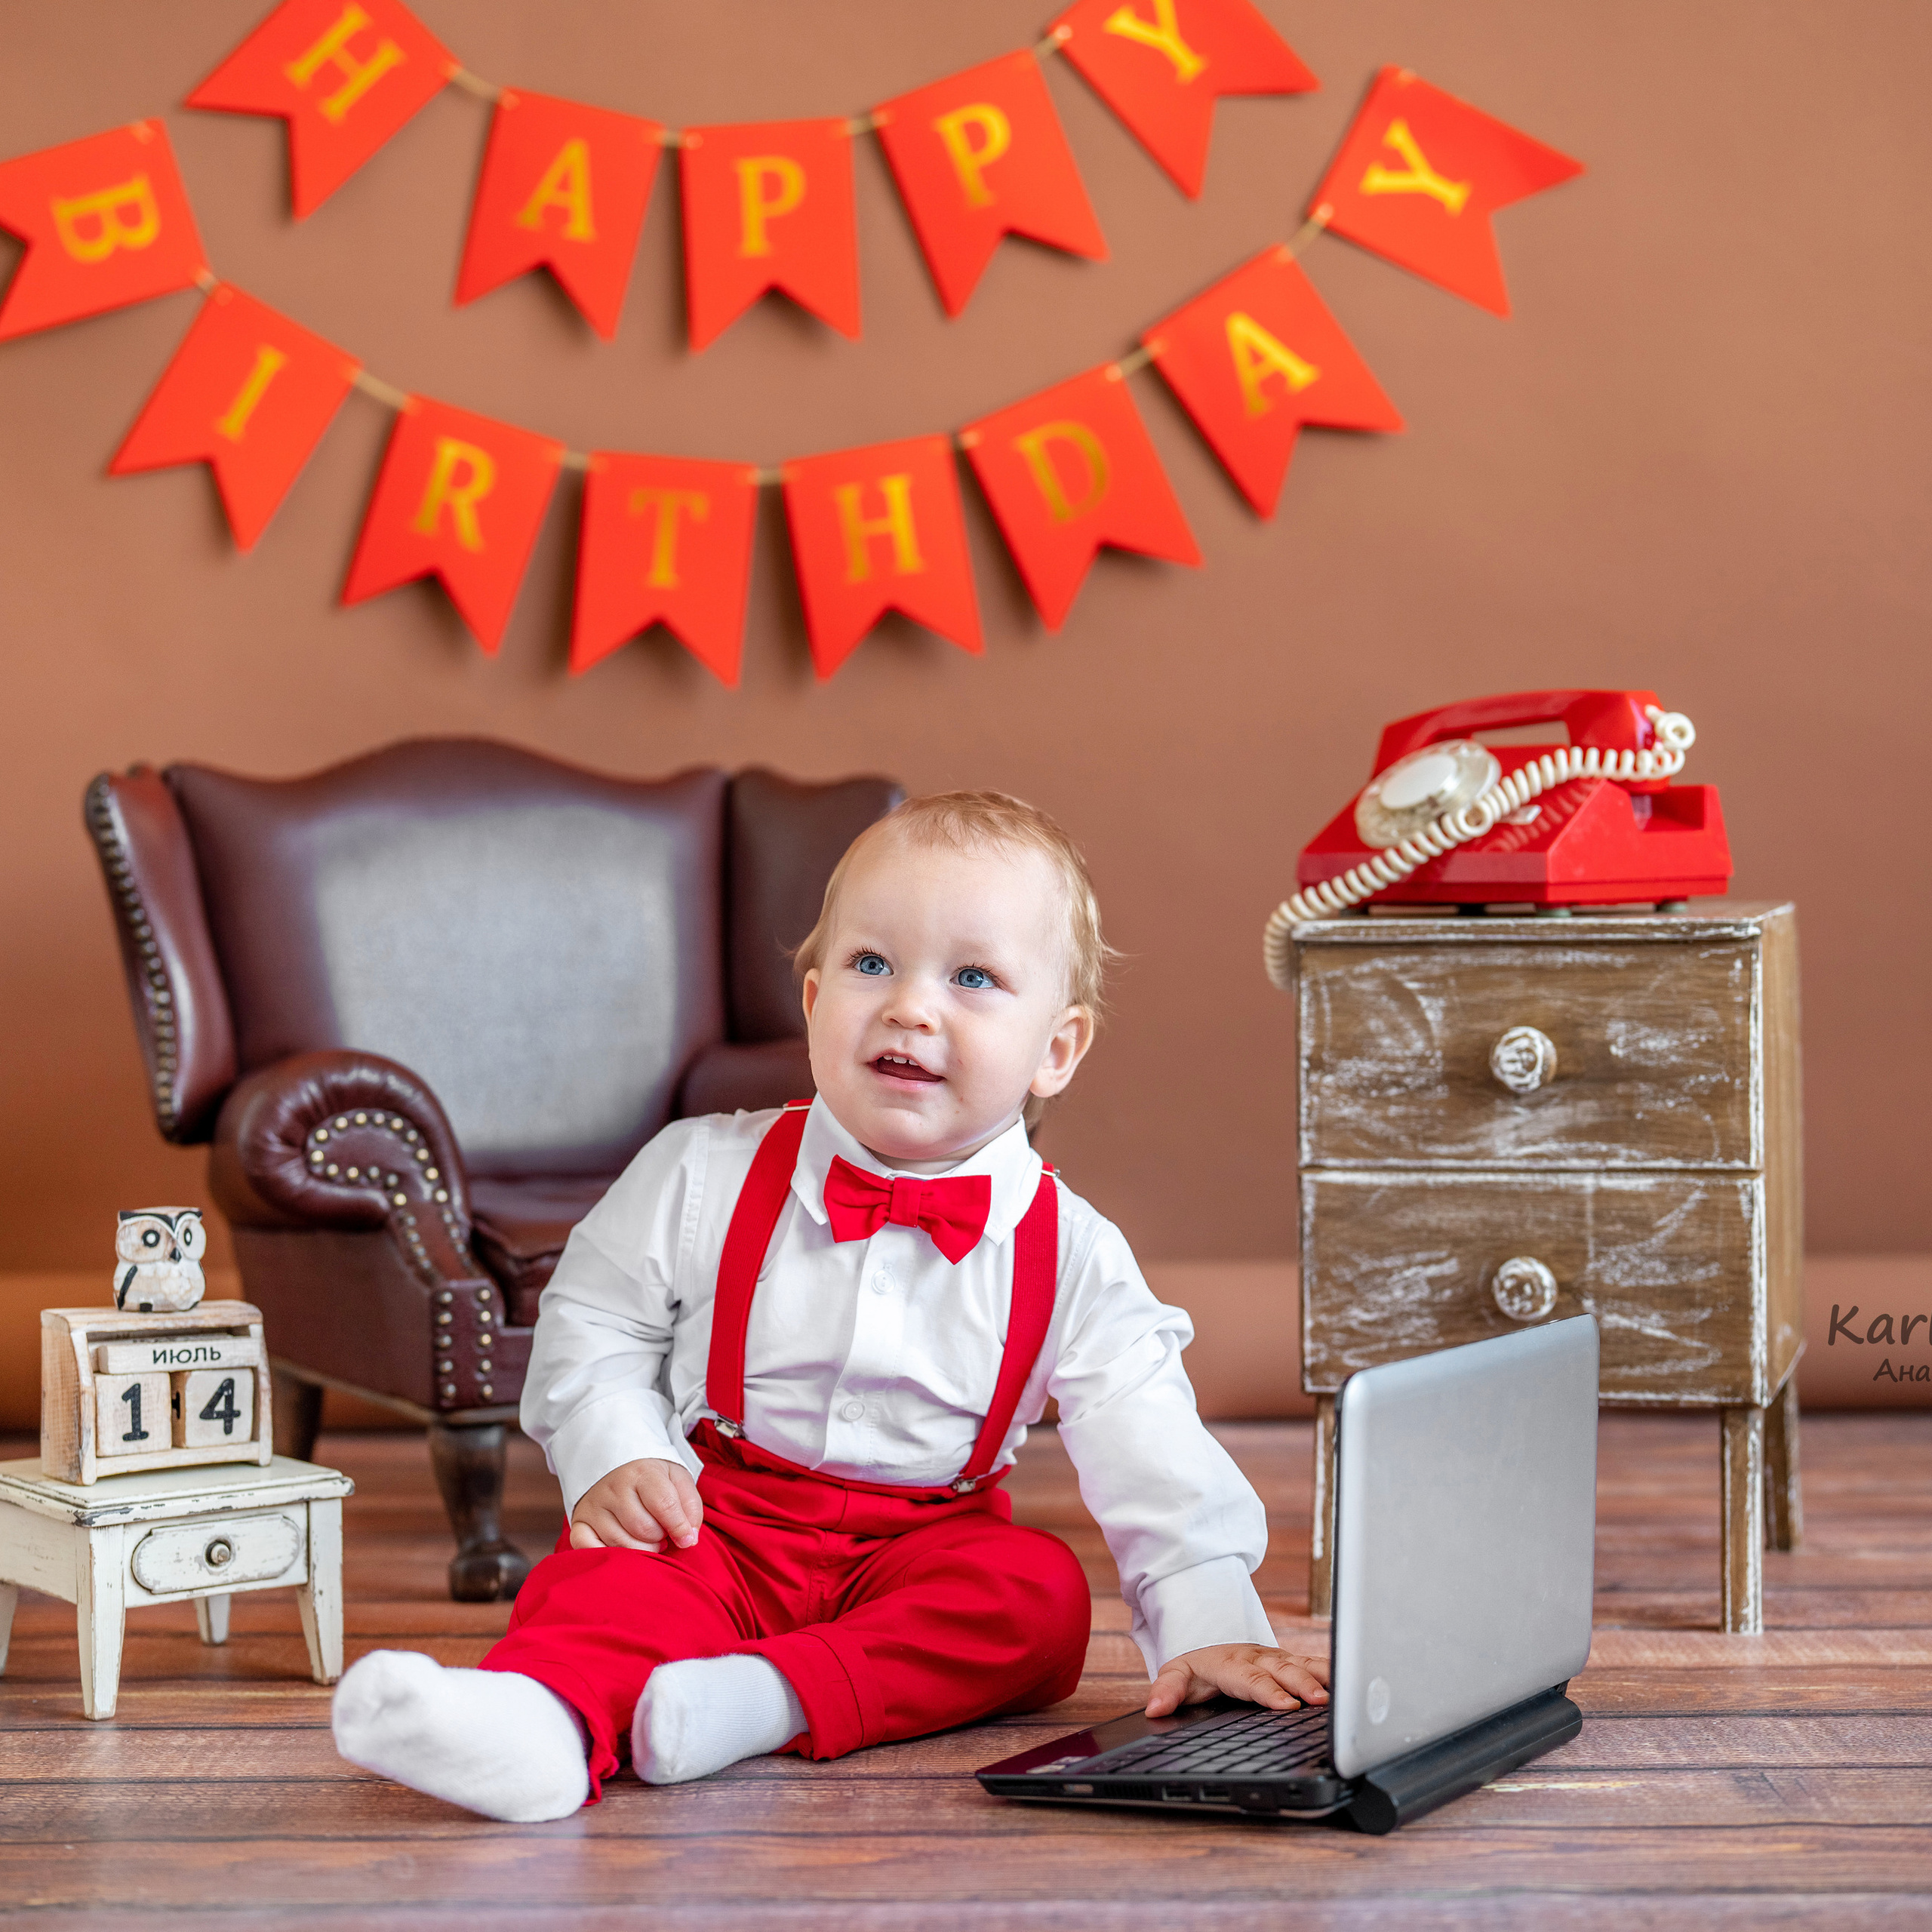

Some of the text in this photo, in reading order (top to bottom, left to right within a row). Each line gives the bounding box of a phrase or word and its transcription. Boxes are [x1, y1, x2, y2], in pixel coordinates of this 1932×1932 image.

[50, 117, 1472, 590] BIRTHDAY
[122, 1383, 149, 1441] 1
[198, 1377, 242, 1435] 4
